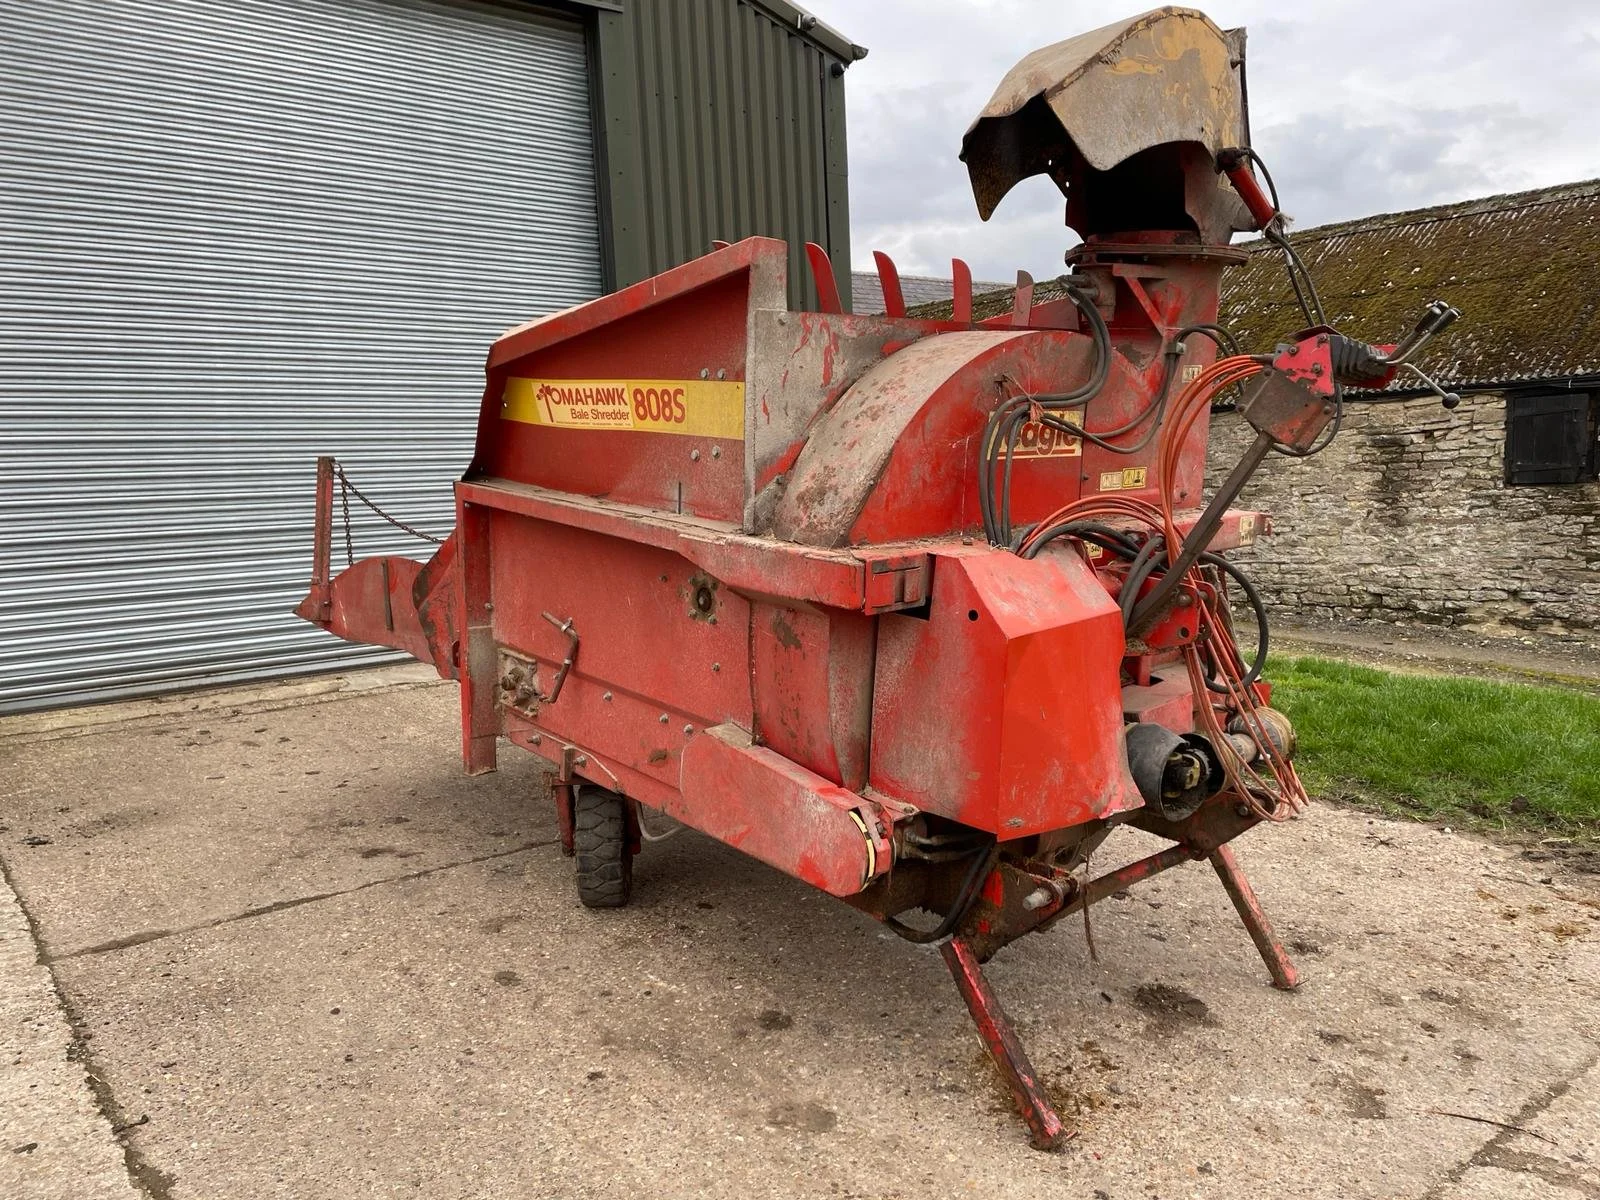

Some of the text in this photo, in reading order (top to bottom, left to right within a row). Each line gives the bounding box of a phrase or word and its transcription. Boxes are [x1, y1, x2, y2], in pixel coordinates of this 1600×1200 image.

[570, 408, 630, 421] Bale Shredder
[633, 387, 686, 424] 808S
